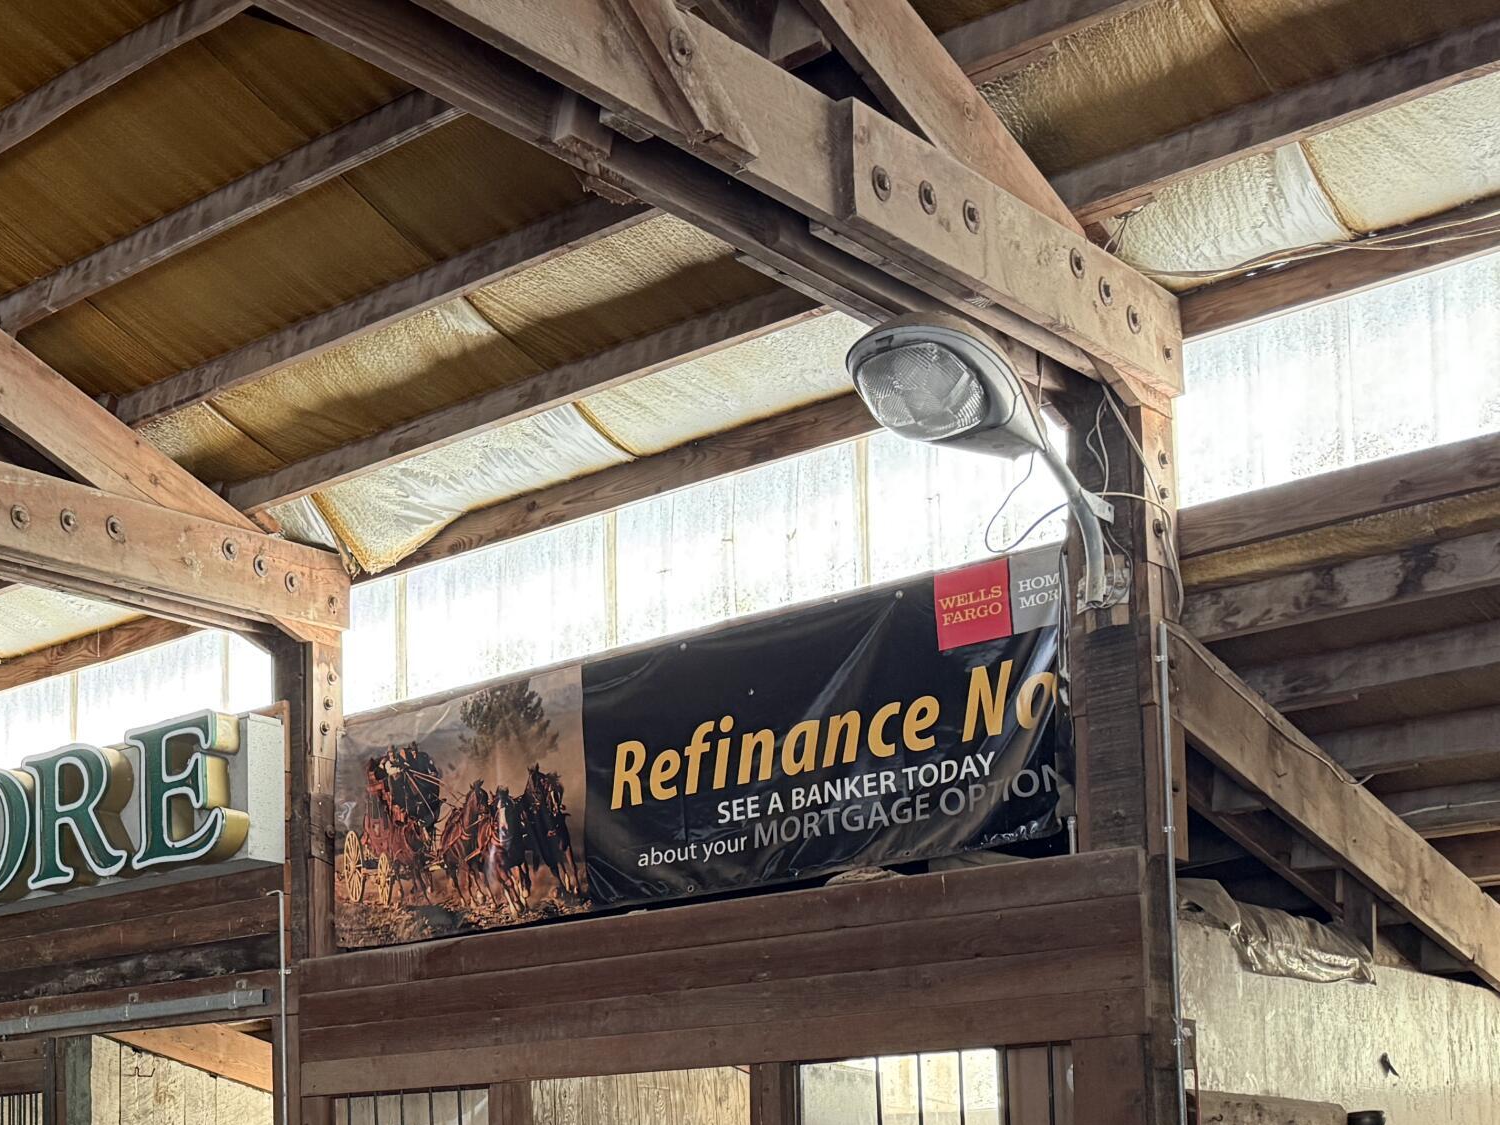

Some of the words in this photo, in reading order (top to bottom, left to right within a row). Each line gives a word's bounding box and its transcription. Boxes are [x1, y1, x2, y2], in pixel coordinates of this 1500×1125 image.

[938, 585, 1002, 610] WELLS
[1017, 572, 1059, 592] HOM
[942, 602, 1002, 626] FARGO
[610, 694, 940, 811] Refinance
[717, 800, 760, 825] SEE
[767, 794, 785, 816] A
[791, 770, 897, 811] BANKER
[904, 751, 996, 792] TODAY
[637, 842, 699, 869] about
[702, 834, 749, 864] your
[753, 791, 932, 850] MORTGAGE
